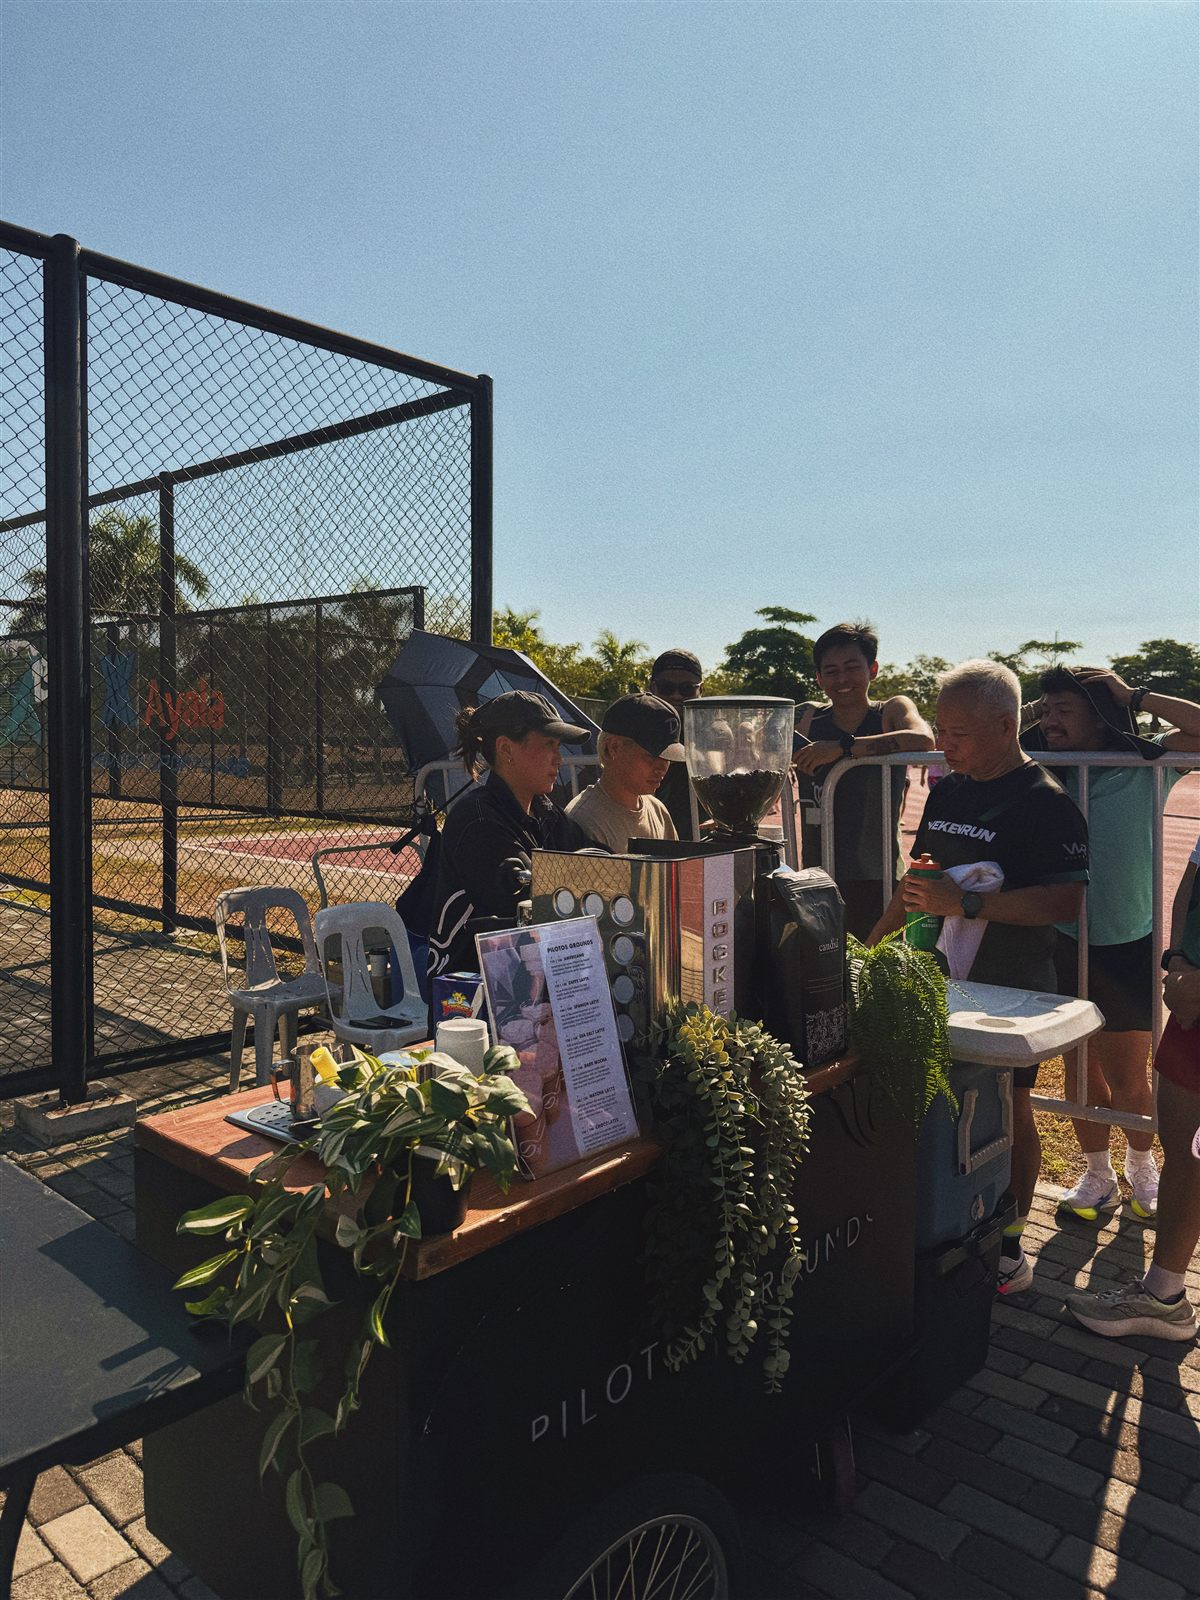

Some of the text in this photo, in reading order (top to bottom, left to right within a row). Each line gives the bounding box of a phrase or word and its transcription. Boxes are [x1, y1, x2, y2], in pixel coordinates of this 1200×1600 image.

[143, 674, 225, 741] Ayala
[547, 939, 594, 953] PILOTOS GROUNDS
[563, 953, 585, 961] AMERICANO
[712, 899, 729, 1017] ROCKE
[594, 1057, 608, 1065] MOCHA
[762, 1213, 873, 1304] ROUND
[531, 1341, 659, 1443] PILOT
